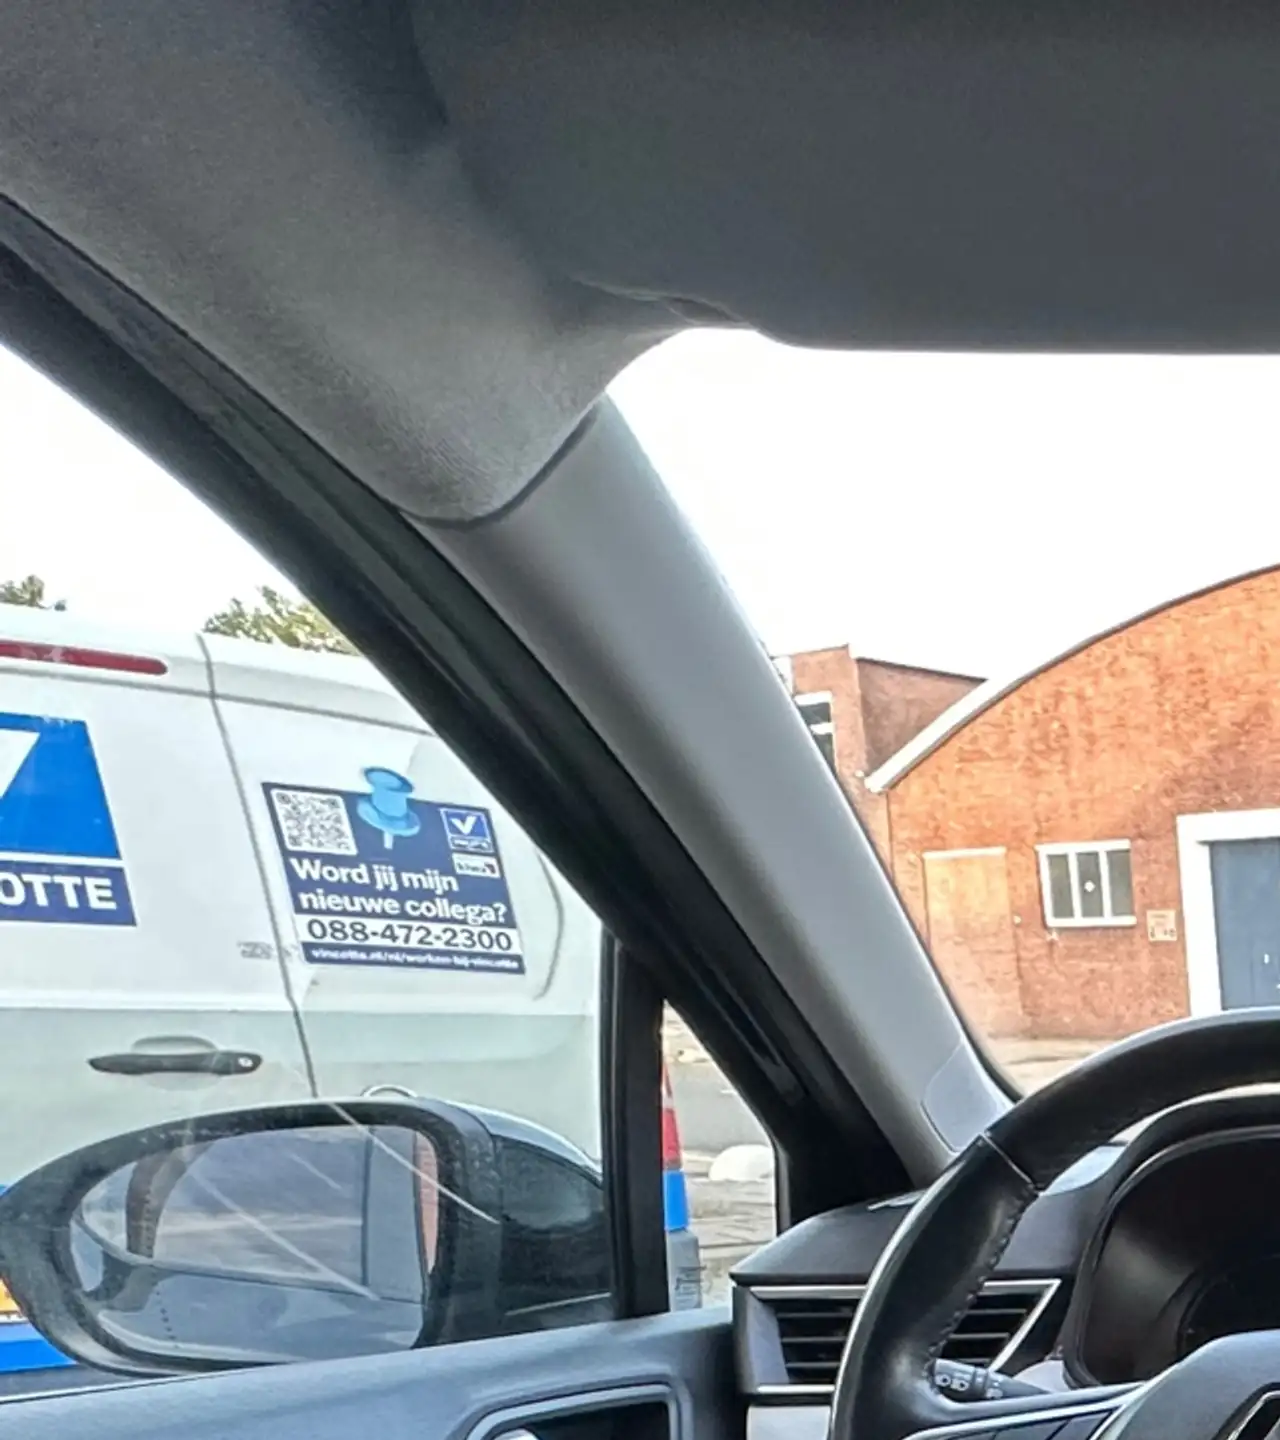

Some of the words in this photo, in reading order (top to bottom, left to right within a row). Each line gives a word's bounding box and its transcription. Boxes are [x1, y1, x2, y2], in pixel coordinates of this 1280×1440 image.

[289, 858, 369, 884] Word
[373, 864, 398, 891] jij
[402, 869, 459, 895] mijn
[298, 889, 400, 914] nieuwe
[405, 898, 507, 925] collega?
[307, 919, 512, 950] 088-472-2300
